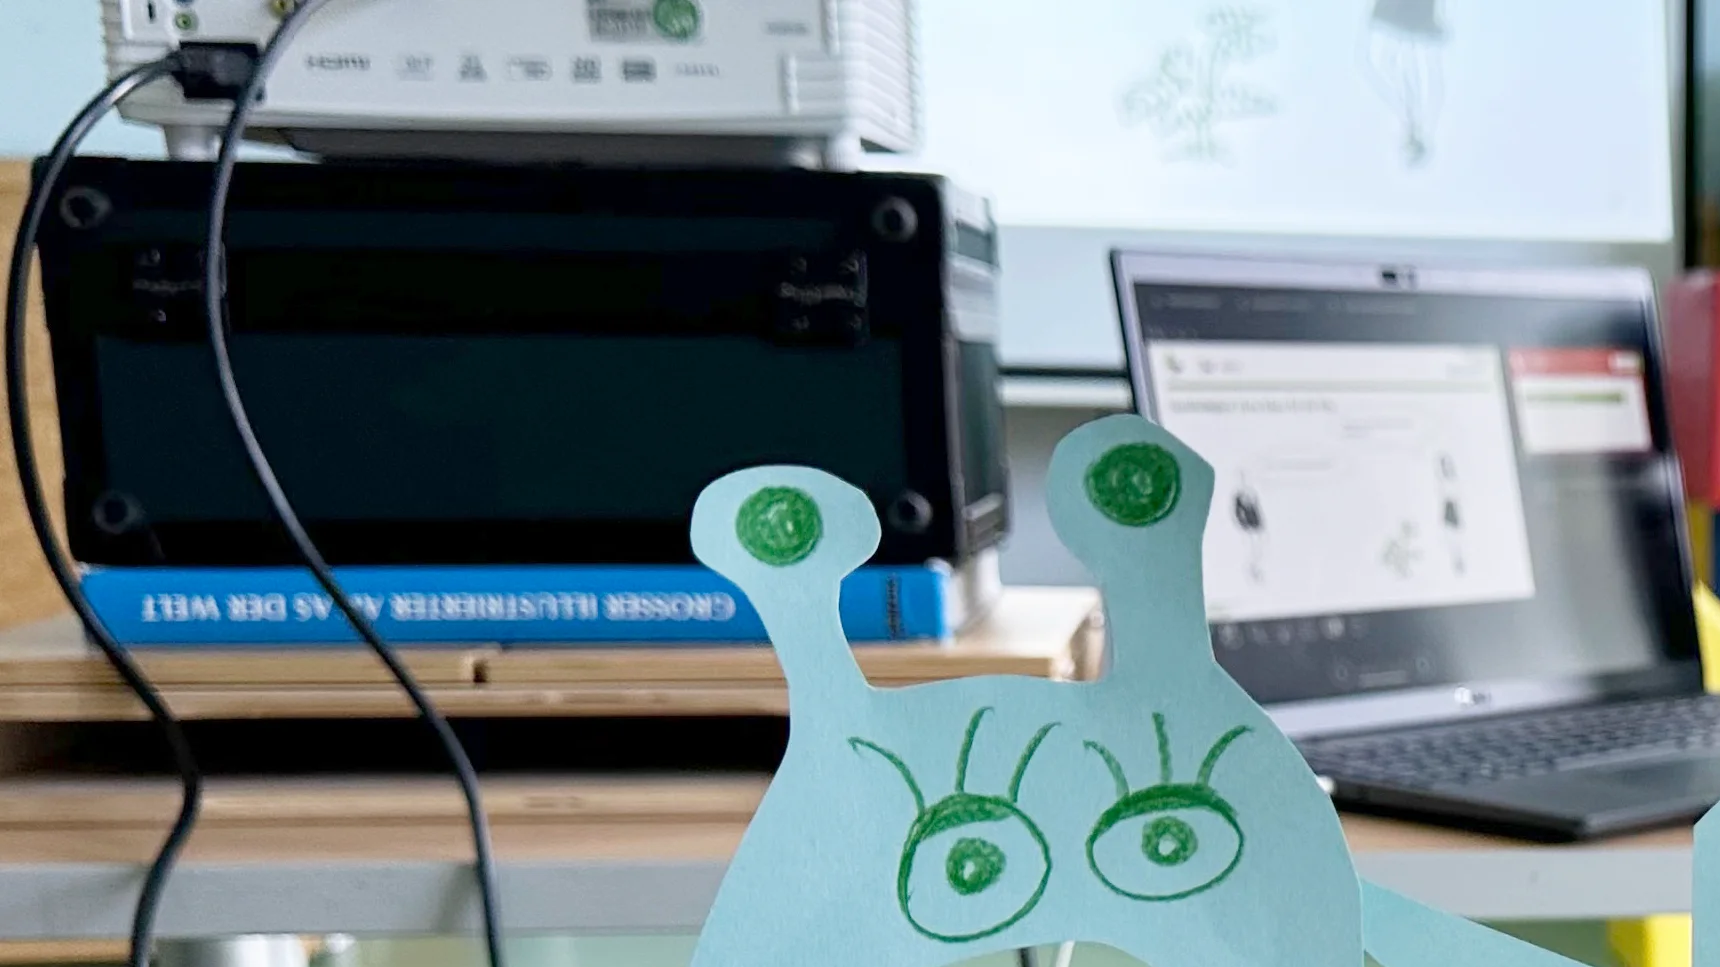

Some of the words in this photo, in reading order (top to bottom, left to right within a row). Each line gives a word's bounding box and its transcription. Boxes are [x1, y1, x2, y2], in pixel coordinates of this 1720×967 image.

[141, 592, 221, 623] WELT
[226, 591, 287, 622] DER
[293, 591, 385, 622] AAS
[389, 591, 597, 622] ILLUSTRIERTER
[602, 591, 737, 622] GROSSER
